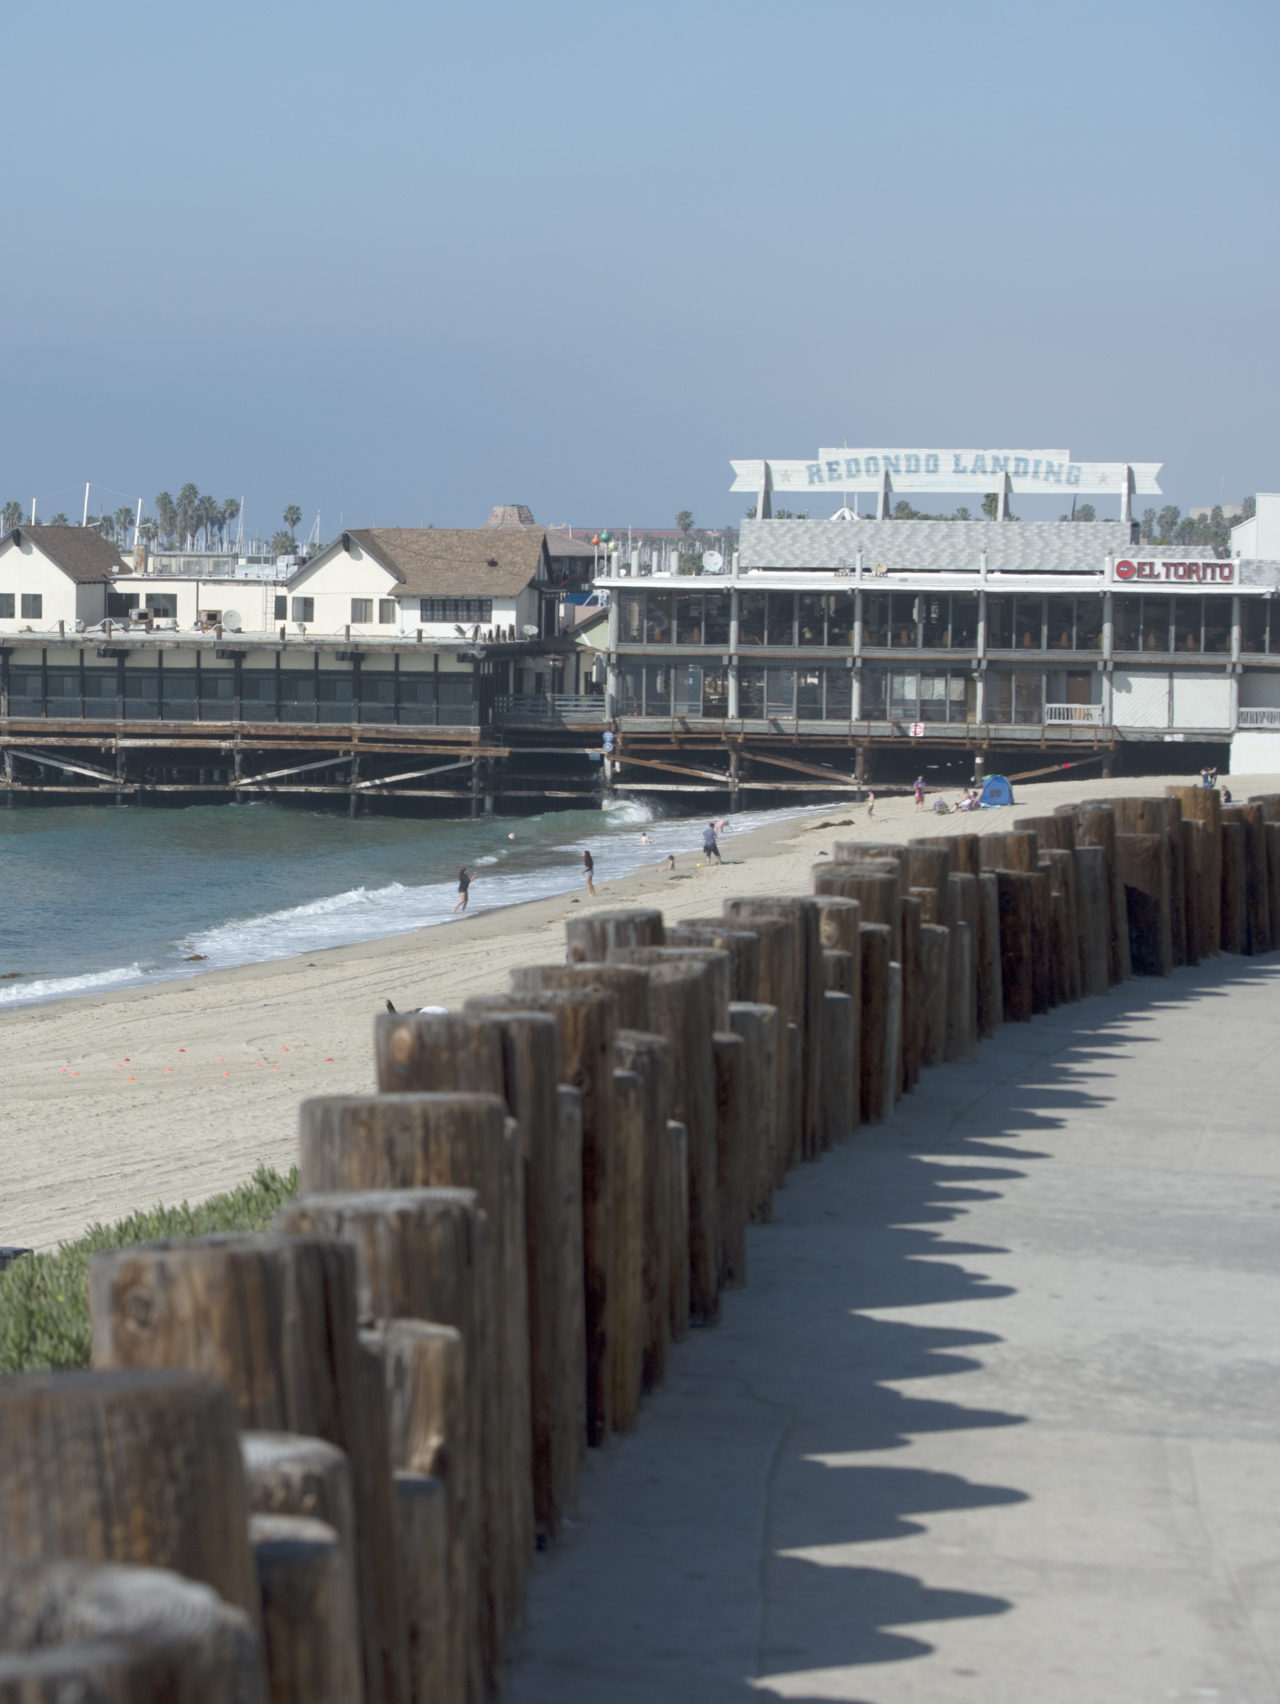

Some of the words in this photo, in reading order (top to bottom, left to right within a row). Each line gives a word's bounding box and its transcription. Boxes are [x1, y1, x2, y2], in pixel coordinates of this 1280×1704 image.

[806, 453, 939, 486] REDONDO
[953, 453, 1081, 485] LANDING
[1136, 561, 1160, 579] EL
[1162, 562, 1234, 582] TORITO
